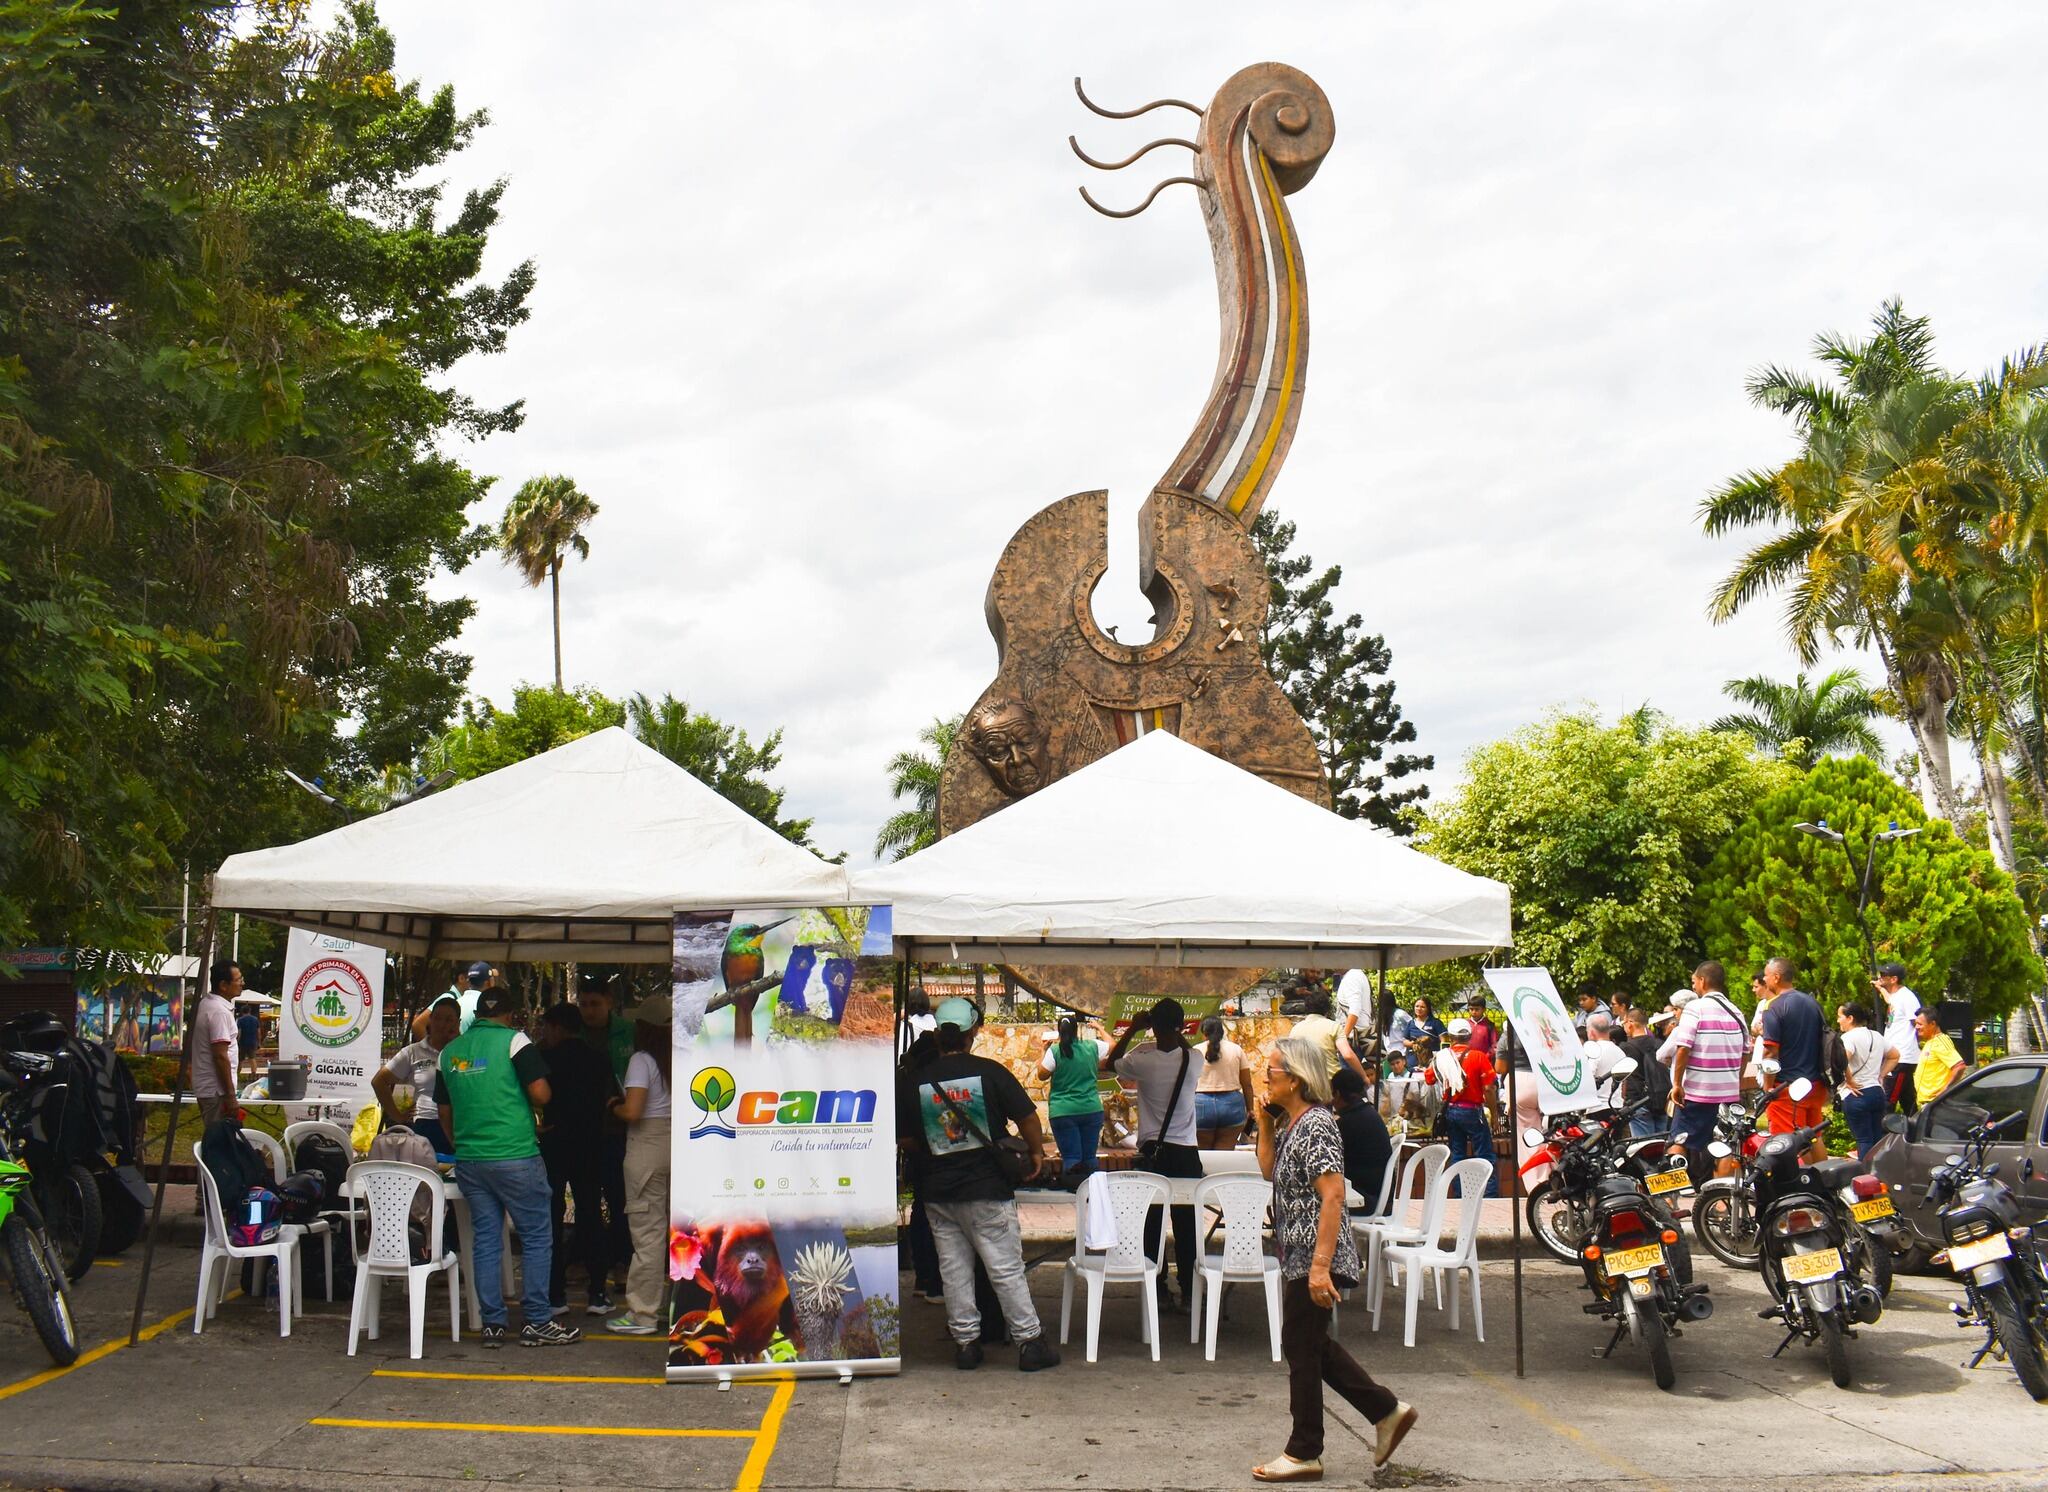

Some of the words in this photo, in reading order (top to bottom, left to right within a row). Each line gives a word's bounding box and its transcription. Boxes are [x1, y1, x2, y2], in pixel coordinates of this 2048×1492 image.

[322, 939, 350, 950] Salud
[318, 961, 351, 972] PRIMARIA
[350, 970, 360, 980] EN
[358, 978, 370, 1004] SALUD
[1126, 995, 1198, 1005] Corpoión
[303, 1026, 330, 1044] GIGANTE
[336, 1031, 357, 1044] HUILA
[316, 1064, 364, 1076] GIGANTE
[736, 1090, 877, 1124] cam
[770, 1138, 802, 1152] ¡Cuida
[806, 1140, 816, 1150] tu
[818, 1137, 872, 1150] naturaleza!
